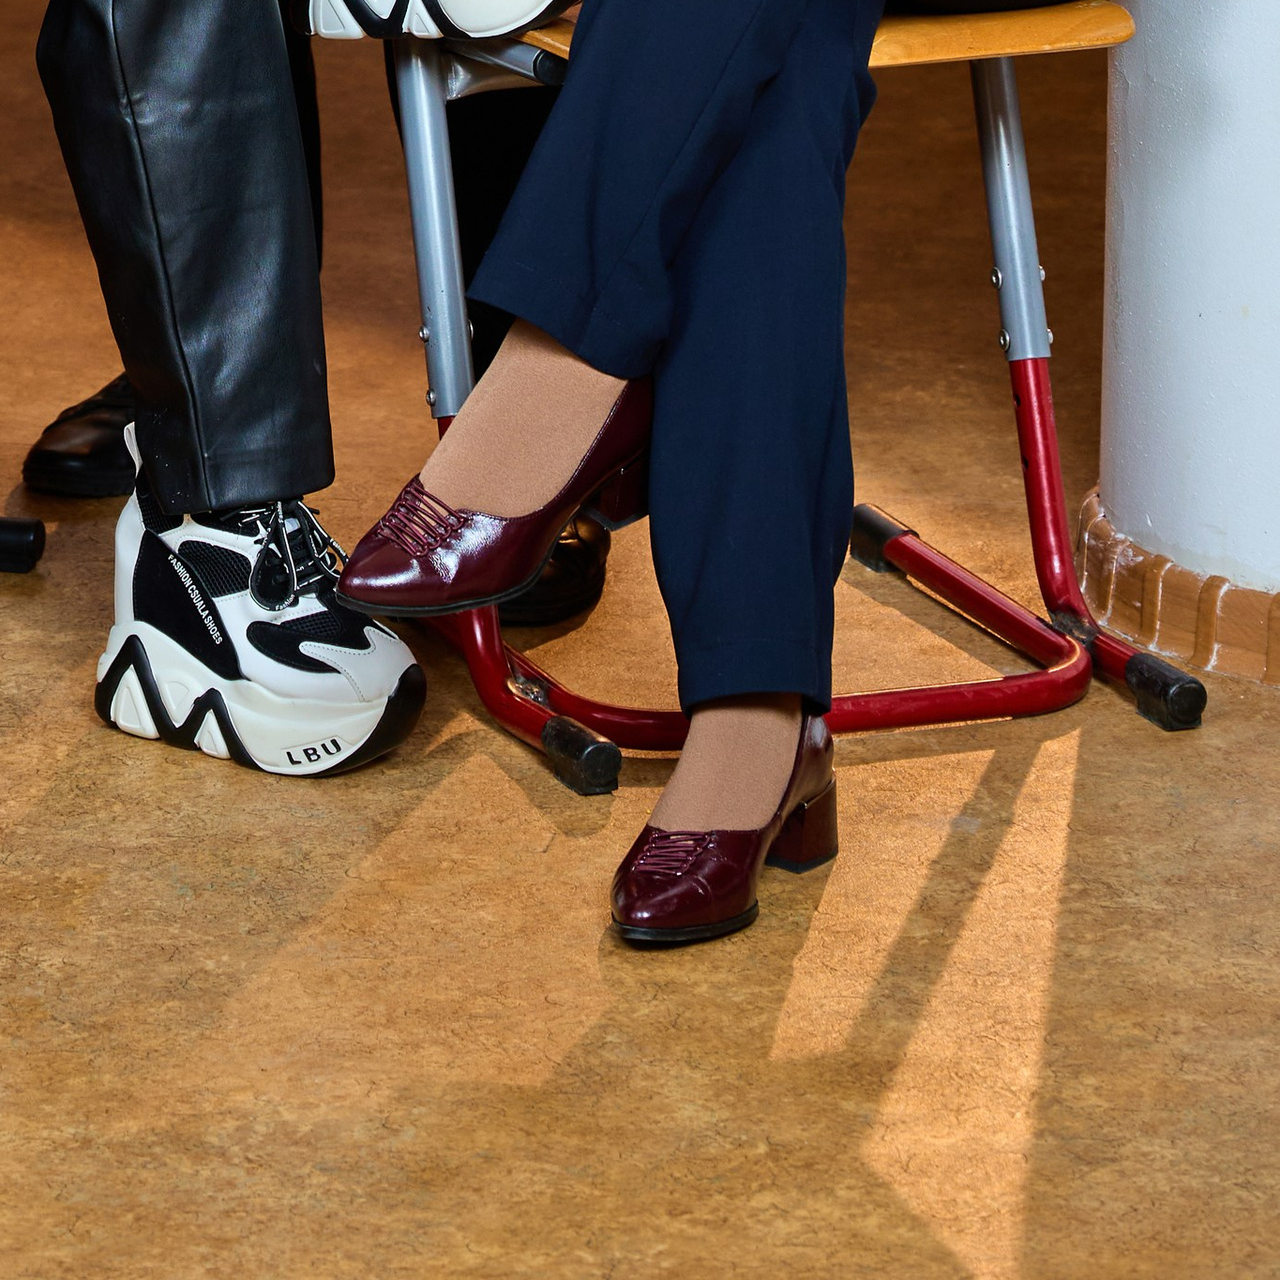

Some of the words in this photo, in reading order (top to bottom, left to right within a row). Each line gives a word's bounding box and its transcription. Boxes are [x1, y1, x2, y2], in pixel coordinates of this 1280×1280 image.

[167, 553, 193, 588] FASHION
[187, 584, 209, 619] CSUALA
[204, 615, 223, 645] SHOES
[275, 594, 296, 611] Fashion
[286, 738, 342, 766] LBU
